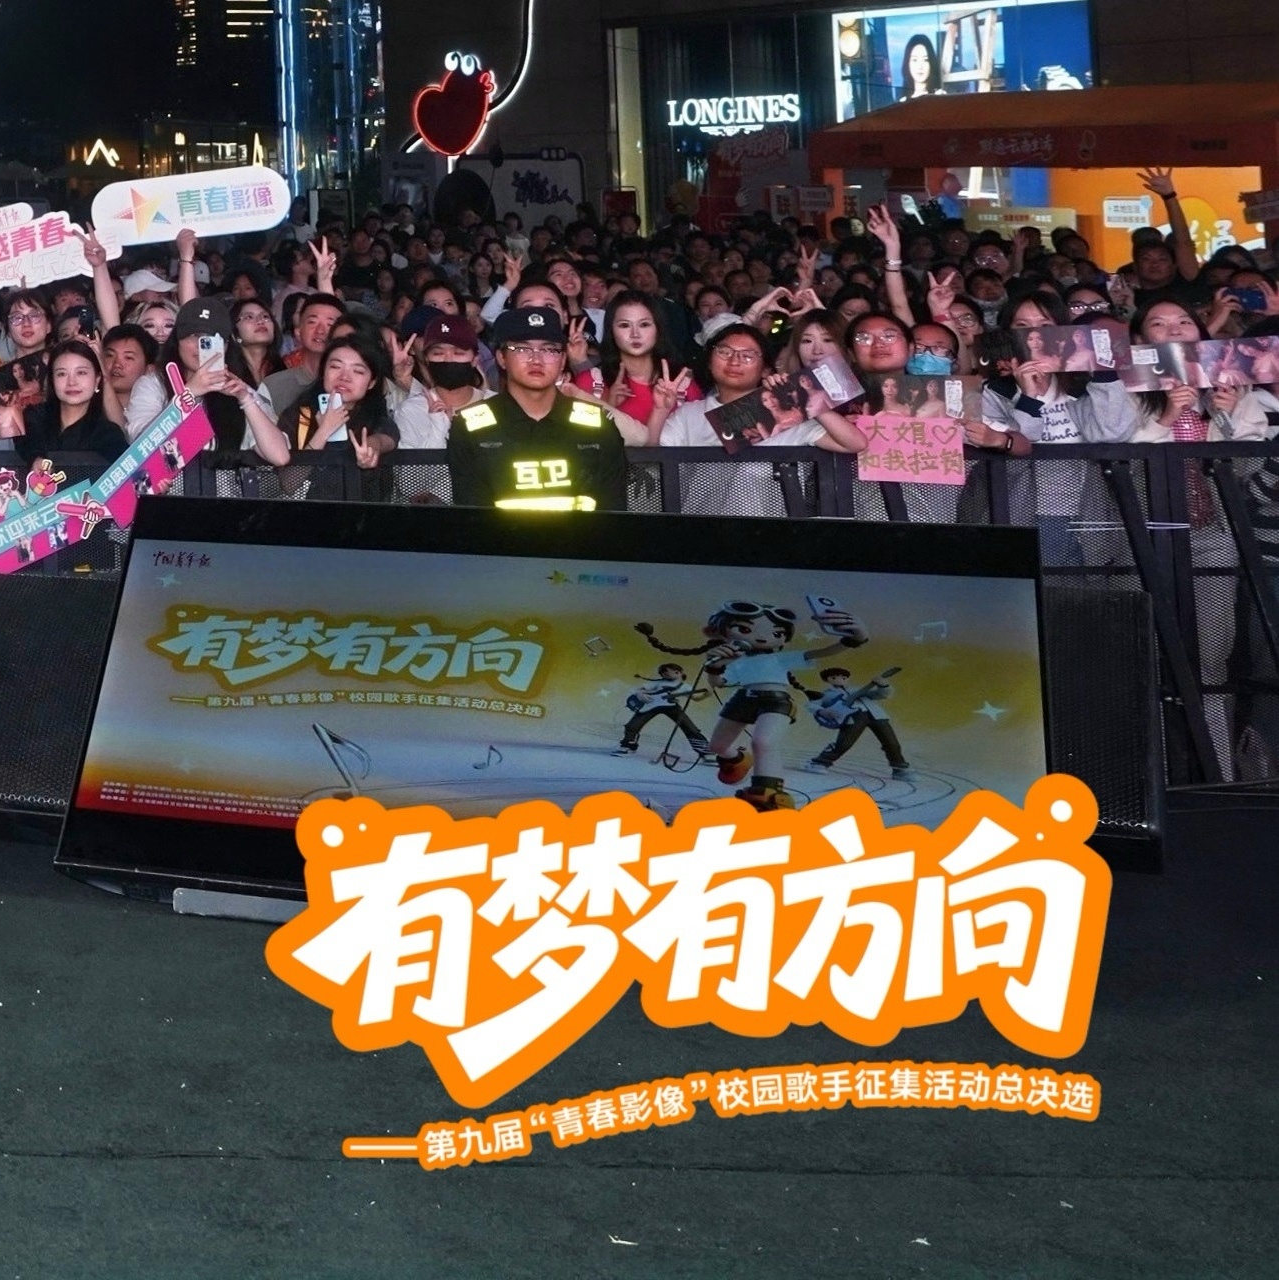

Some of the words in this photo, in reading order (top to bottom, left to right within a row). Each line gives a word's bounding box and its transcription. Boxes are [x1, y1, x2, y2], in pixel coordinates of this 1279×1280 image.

[666, 93, 802, 127] LONGINES
[176, 185, 274, 217] 青春影像
[513, 459, 572, 490] 互卫
[156, 614, 545, 693] 有梦有方向
